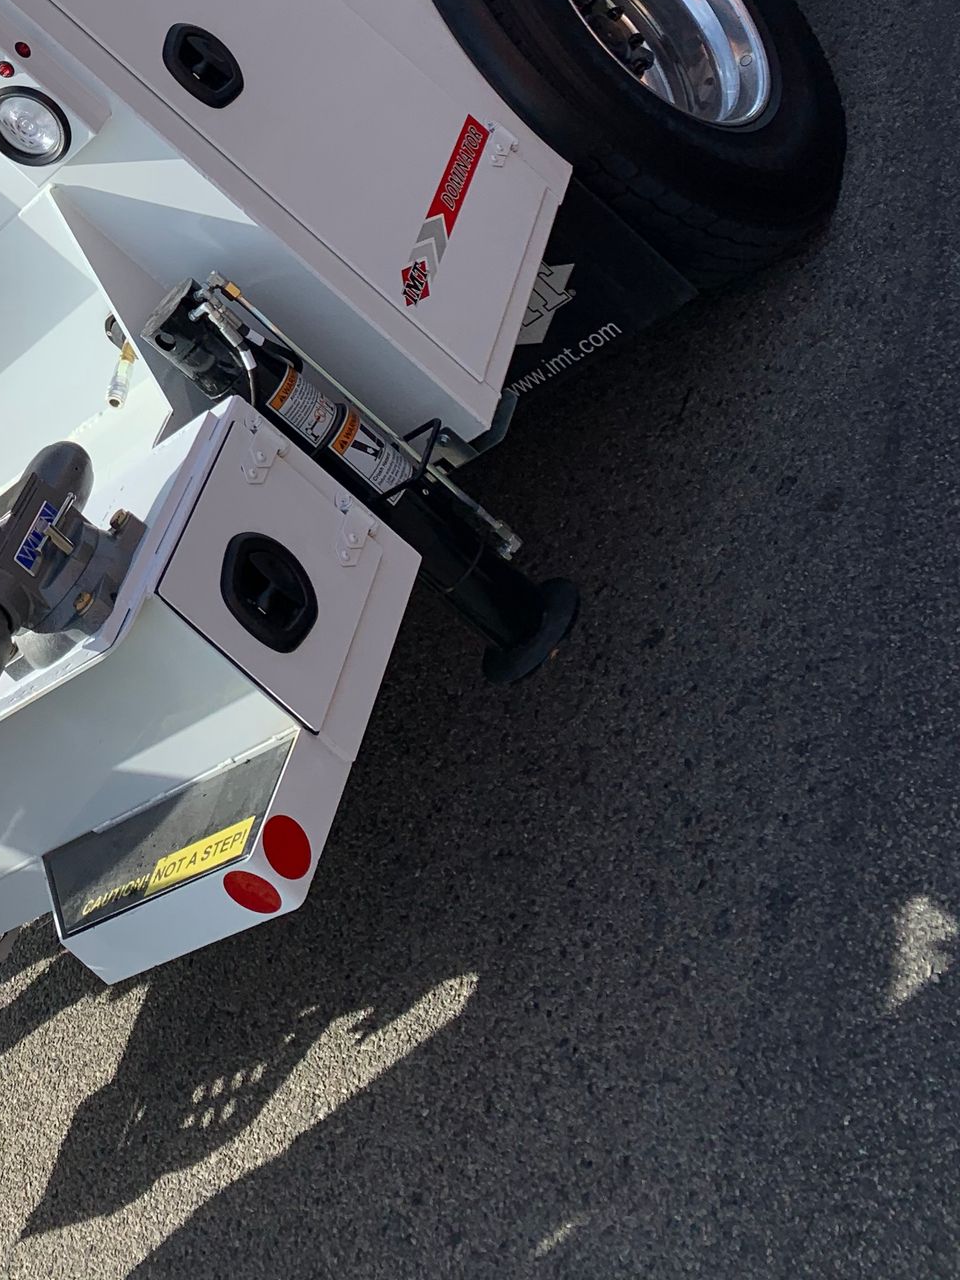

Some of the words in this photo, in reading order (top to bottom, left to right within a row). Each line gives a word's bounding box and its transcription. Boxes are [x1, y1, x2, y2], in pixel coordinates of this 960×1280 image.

[441, 124, 483, 211] DOMINATOR
[401, 261, 428, 305] IMT
[372, 466, 384, 481] Crush
[83, 873, 149, 916] CAUTION!
[155, 856, 186, 882] NOT
[189, 851, 199, 866] A
[200, 828, 247, 862] STEP!
